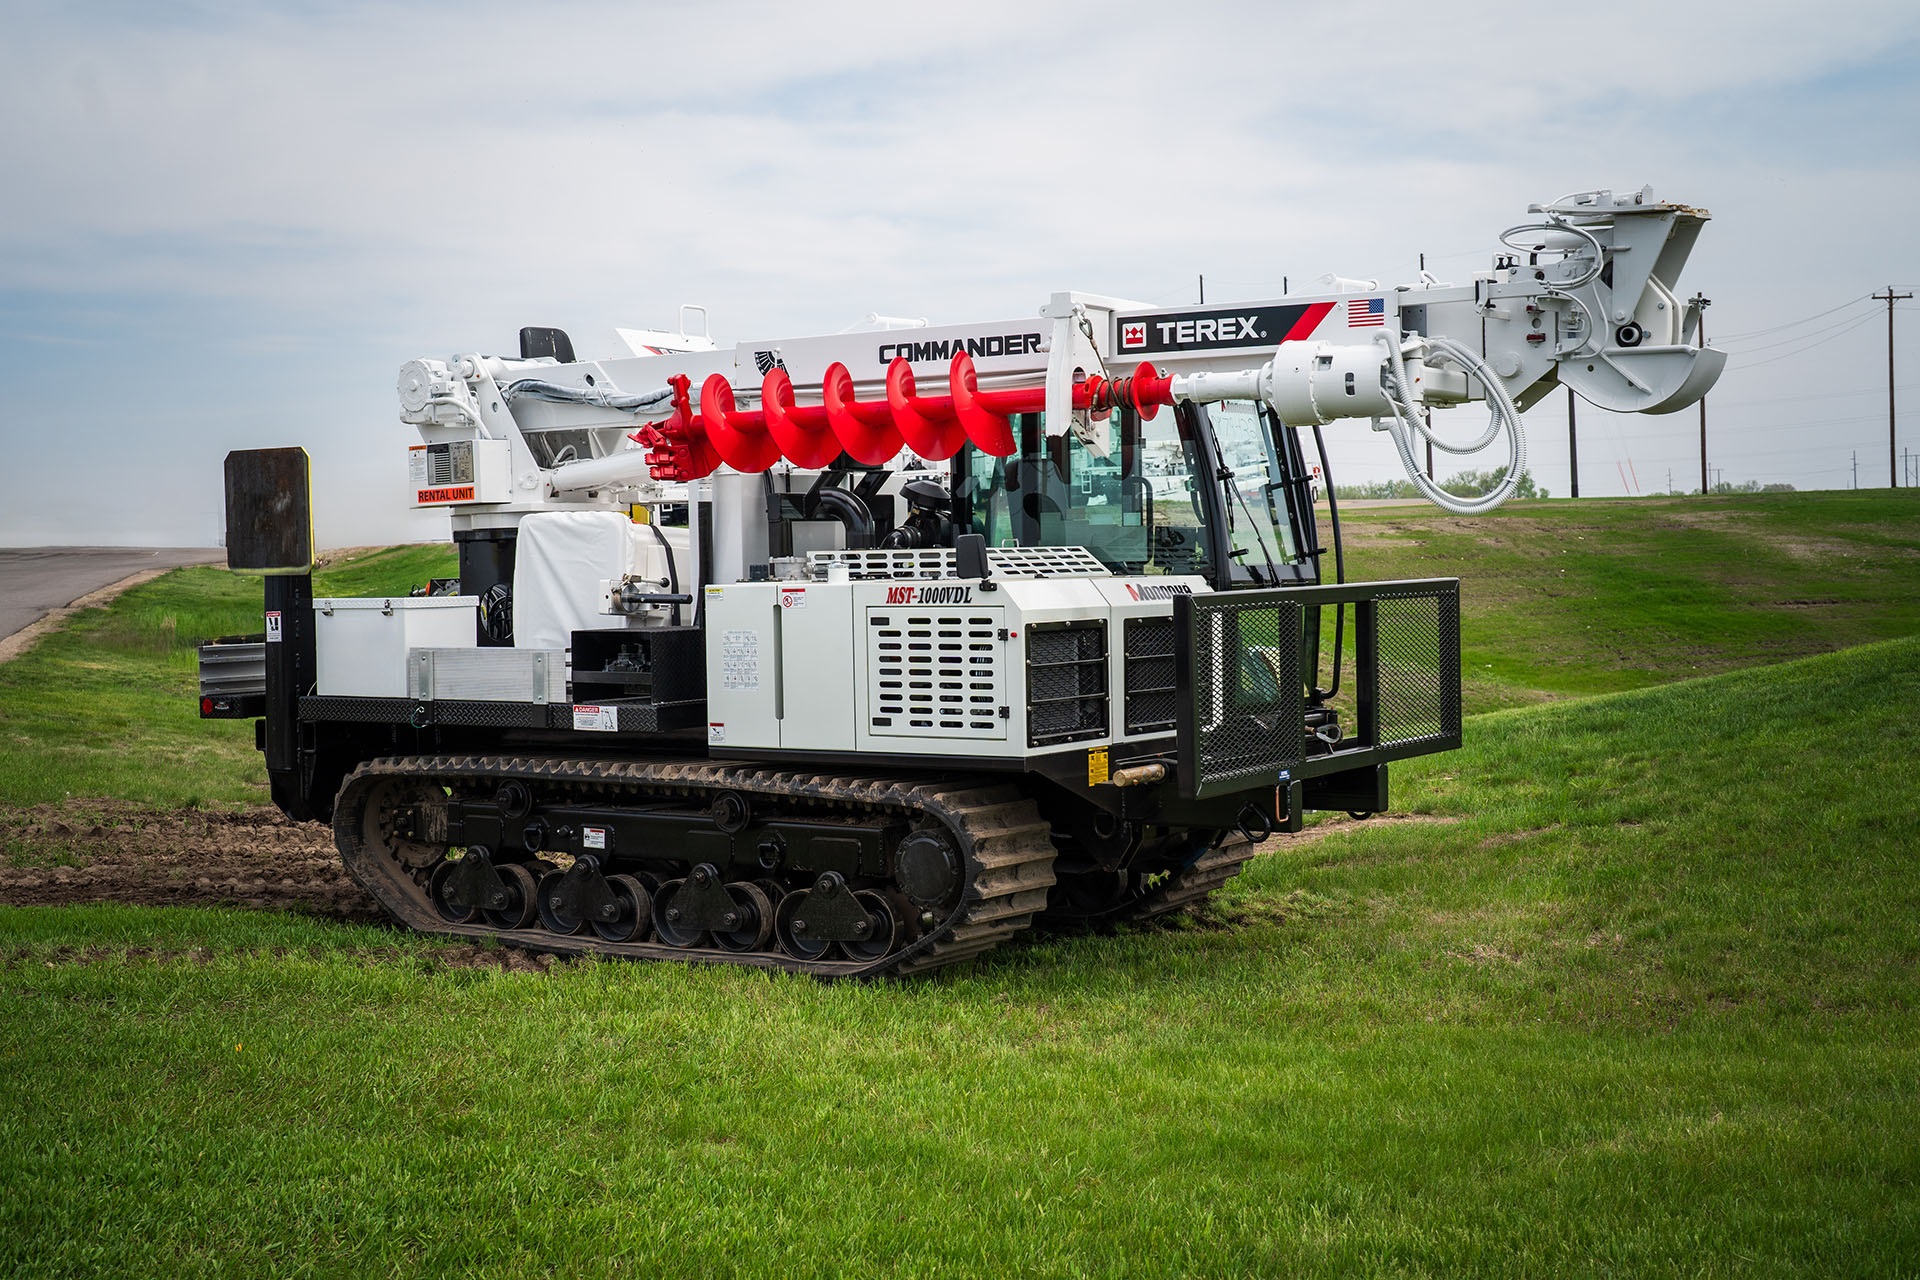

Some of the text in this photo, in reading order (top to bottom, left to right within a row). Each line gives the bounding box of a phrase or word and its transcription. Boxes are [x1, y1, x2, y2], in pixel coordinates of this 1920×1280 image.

[879, 333, 1041, 365] COMMANDER
[418, 487, 474, 502] RENTAL UNIT
[886, 586, 973, 604] MST-1000VDL
